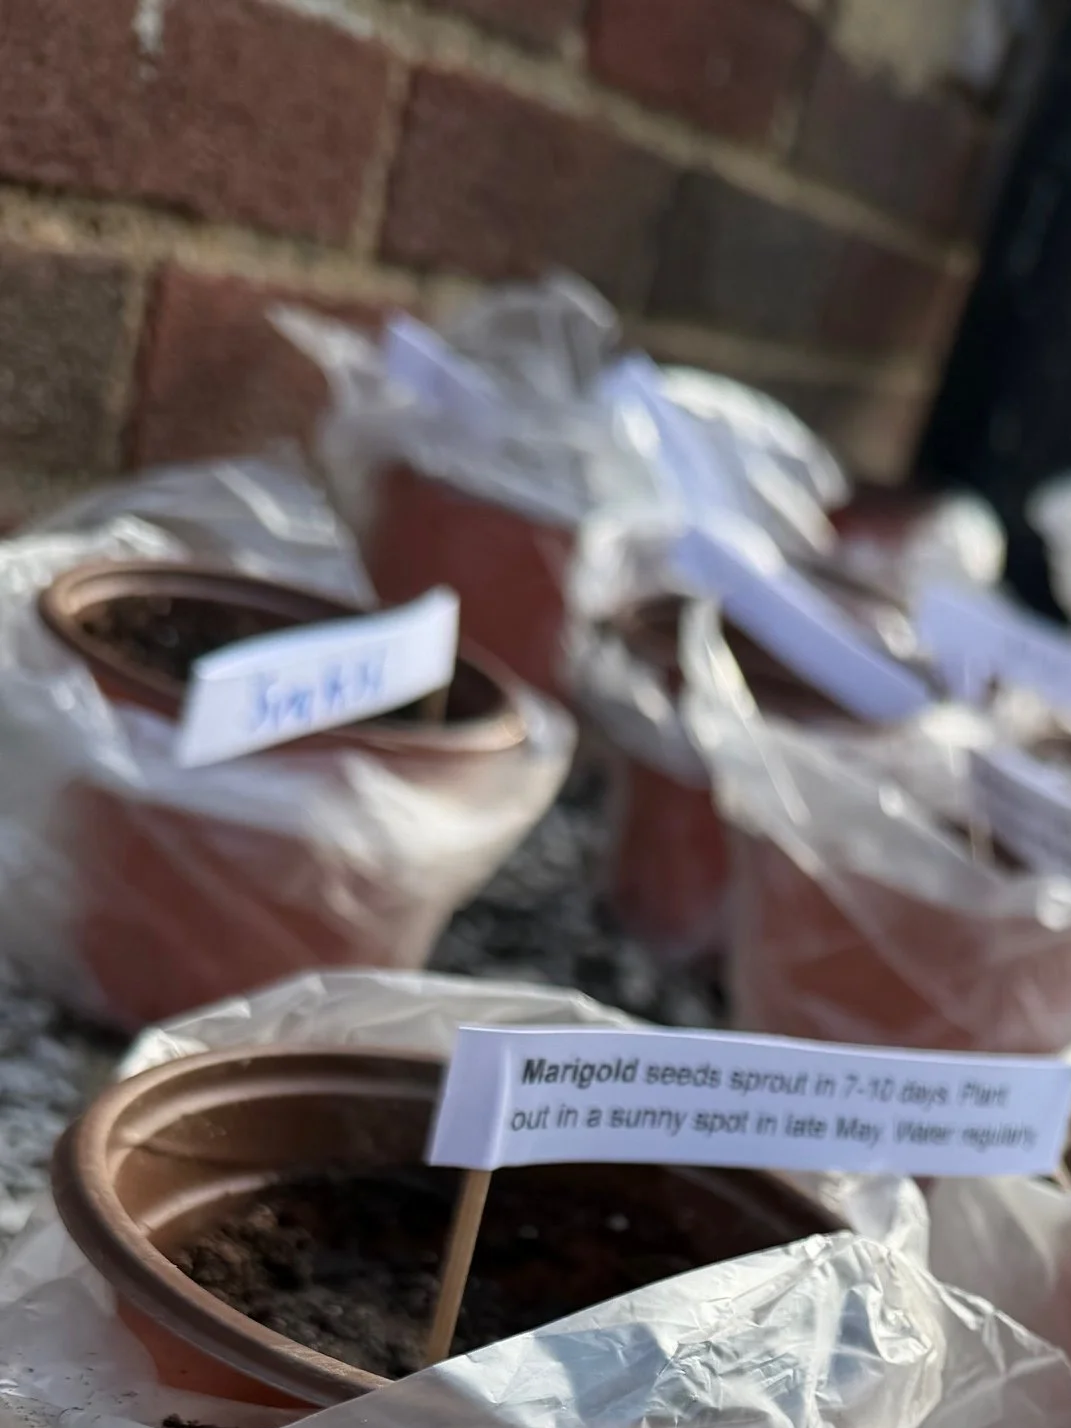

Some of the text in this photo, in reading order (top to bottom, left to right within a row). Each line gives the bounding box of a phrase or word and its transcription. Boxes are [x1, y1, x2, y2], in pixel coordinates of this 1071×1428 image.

[523, 1058, 639, 1090] Marigold
[646, 1063, 722, 1089] seeds
[729, 1070, 809, 1097] sprout
[815, 1073, 837, 1098] in
[844, 1073, 896, 1103] 7-10
[510, 1104, 550, 1131] out
[556, 1104, 578, 1129] in
[586, 1106, 602, 1129] a
[609, 1106, 687, 1137] sunny
[690, 1108, 749, 1136] spot
[755, 1112, 779, 1136] in
[784, 1114, 827, 1141] late
